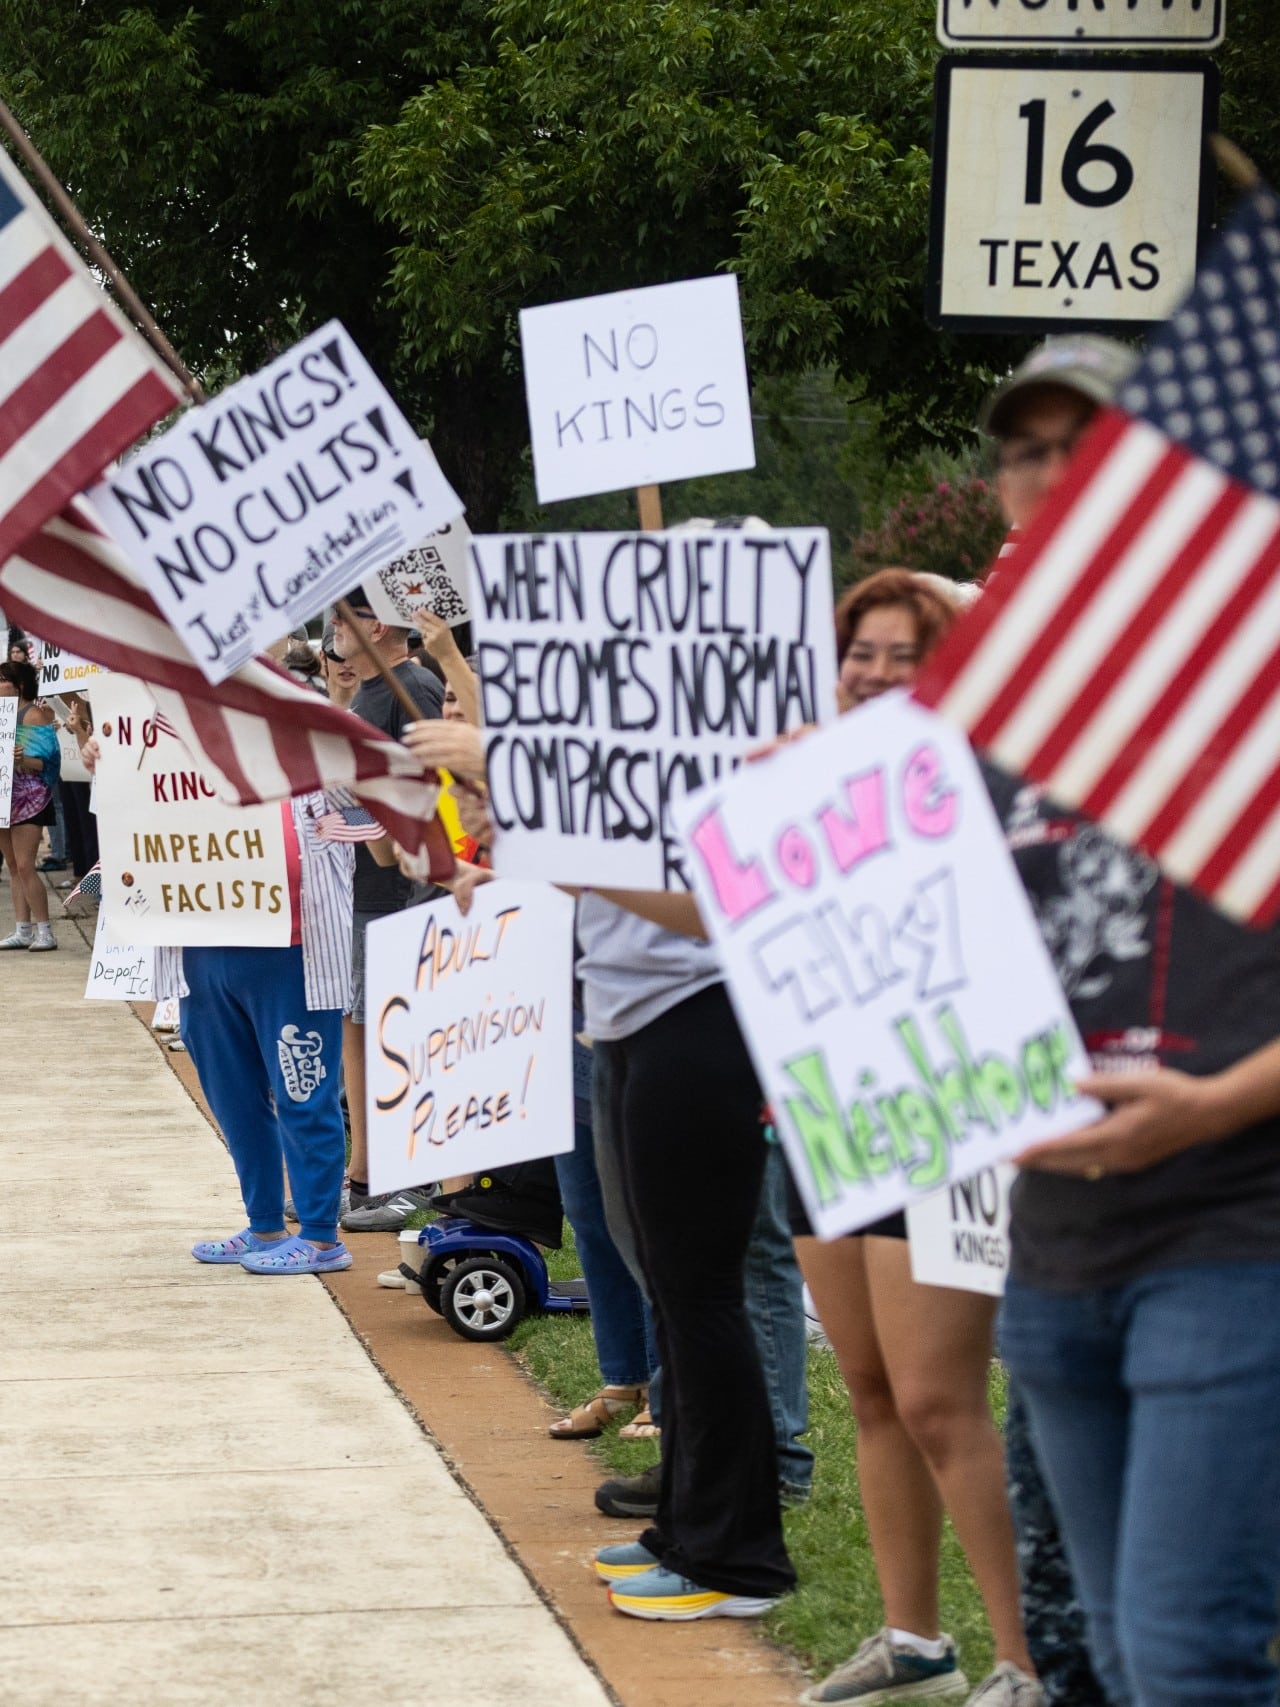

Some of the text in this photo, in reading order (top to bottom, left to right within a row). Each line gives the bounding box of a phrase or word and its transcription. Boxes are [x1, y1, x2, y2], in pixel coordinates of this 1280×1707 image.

[1019, 98, 1134, 208] 16
[979, 239, 1161, 291] TEXAS
[583, 322, 659, 379] NO
[111, 337, 358, 540] NO KINGS!
[555, 384, 726, 448] KINGS
[155, 406, 401, 601] NO CULTS!
[470, 537, 819, 648] WHEN CRUELTY
[187, 613, 250, 662] Just
[43, 664, 102, 682] NO OLIGAR
[478, 638, 658, 732] BECOMES
[118, 716, 158, 748] NO
[133, 829, 264, 863] IMPEACH
[161, 879, 283, 914] FACISTS
[94, 957, 146, 986] Deport
[414, 905, 522, 991] ADULT
[125, 977, 153, 995] IC
[282, 1059, 298, 1093] TEXAS
[949, 1167, 999, 1227] NO
[955, 1230, 1006, 1269] KINGS
